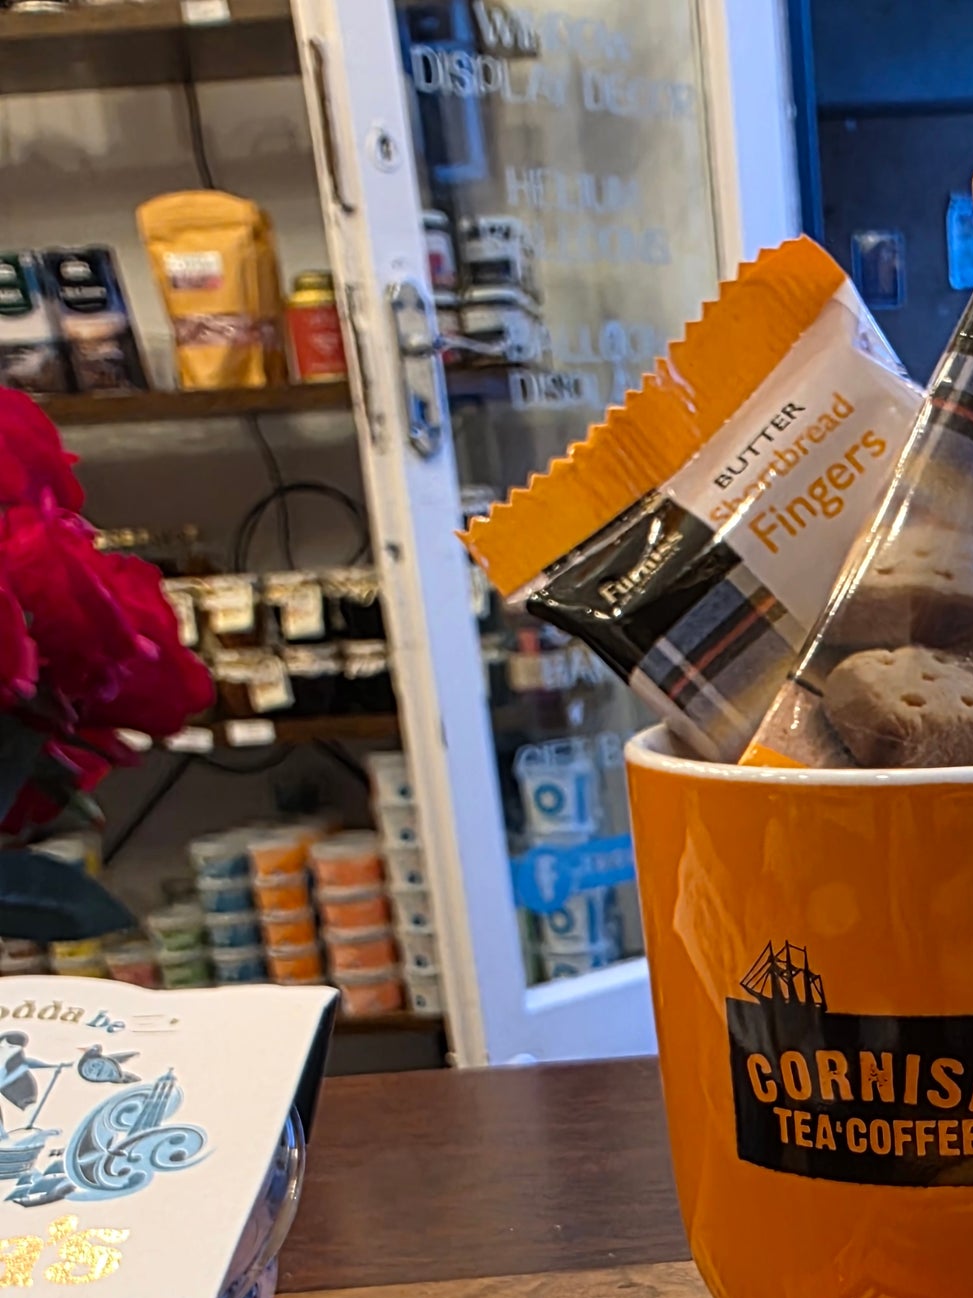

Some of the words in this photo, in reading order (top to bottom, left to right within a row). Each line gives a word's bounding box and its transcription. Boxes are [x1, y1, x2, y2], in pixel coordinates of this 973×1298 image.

[714, 402, 806, 490] BUTTER
[750, 430, 886, 554] Fingers
[773, 1107, 837, 1151] TEA
